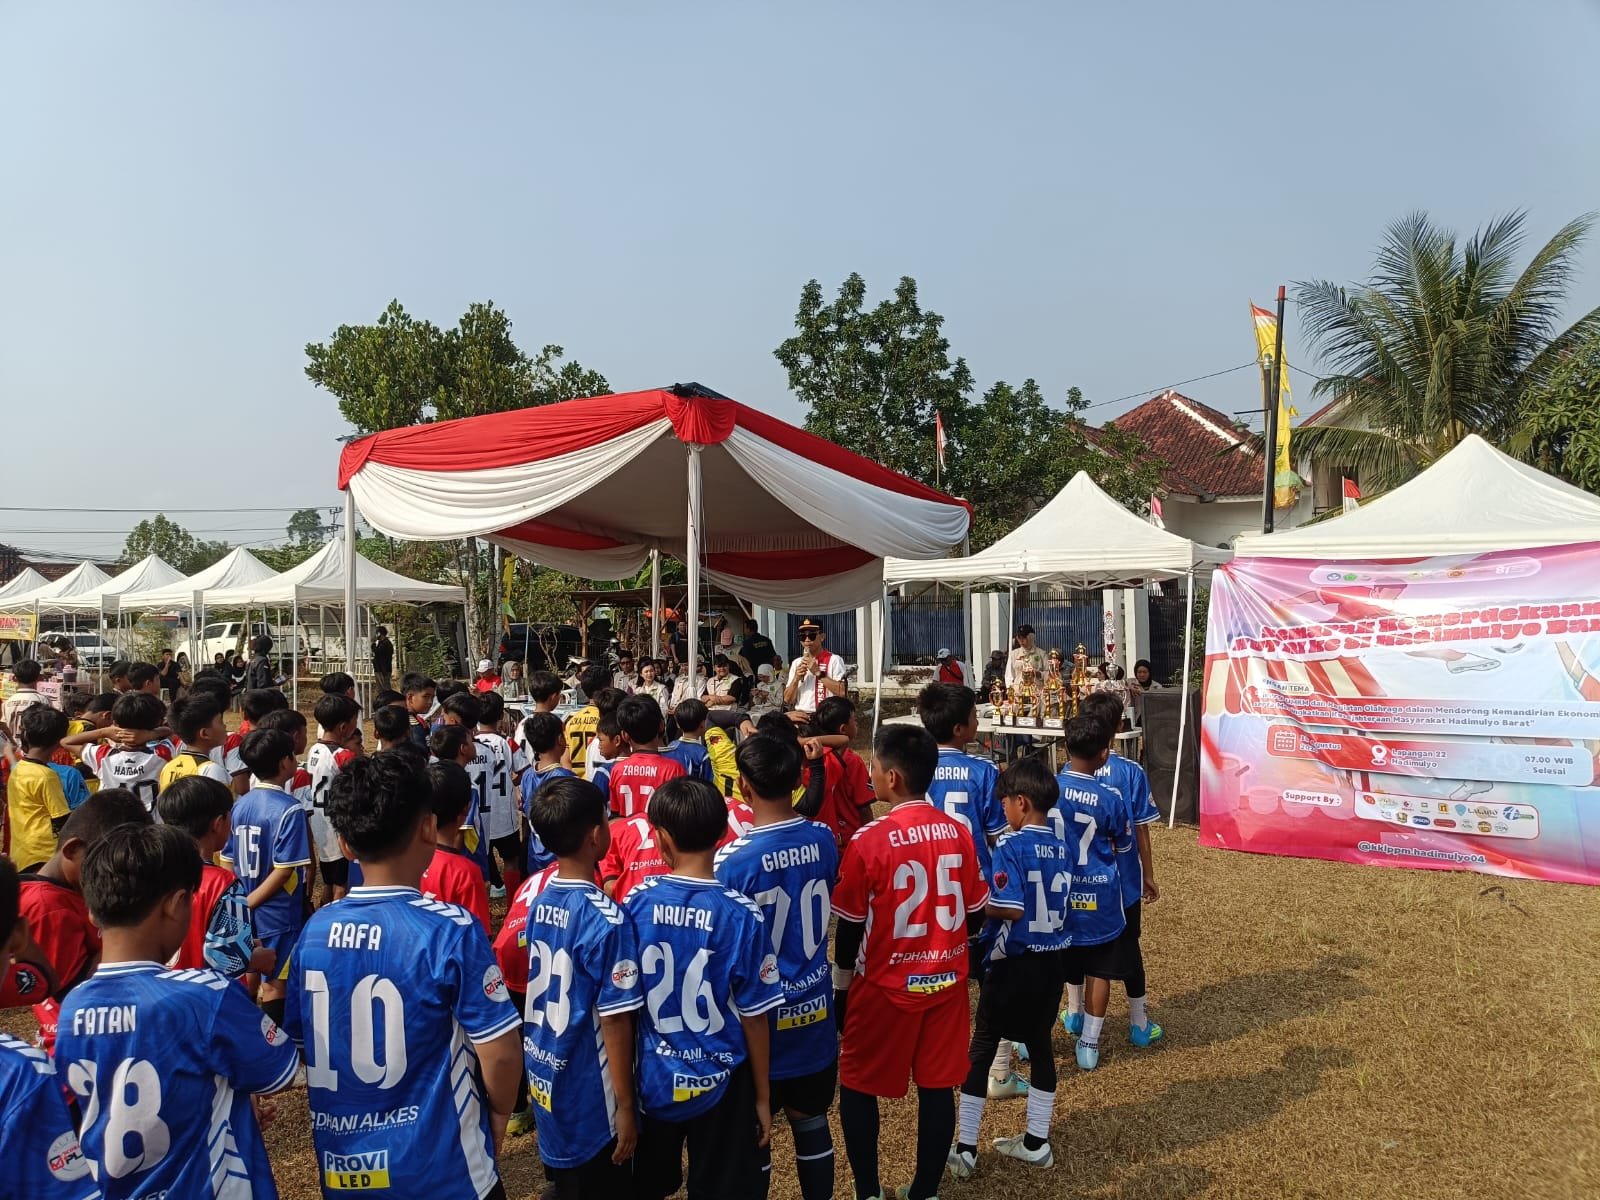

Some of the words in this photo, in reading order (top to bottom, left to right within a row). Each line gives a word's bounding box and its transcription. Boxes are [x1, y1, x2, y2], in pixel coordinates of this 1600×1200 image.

[1393, 716, 1446, 725] Masyarakat
[1448, 717, 1500, 727] Hadimulyo
[1406, 705, 1433, 714] dalam
[1435, 707, 1490, 717] Mendorong
[1491, 708, 1555, 717] Kemandirian
[1391, 758, 1437, 769] Hadimulyo
[1392, 748, 1433, 759] Lapangan
[1435, 750, 1447, 758] 22
[1524, 756, 1551, 764] 07.00
[1554, 757, 1574, 765] WIB
[1532, 766, 1566, 776] Selesai
[1064, 786, 1099, 807] UMAR
[1285, 791, 1321, 802] Support
[1323, 796, 1335, 805] By
[888, 823, 959, 848] ELBIVARO
[761, 843, 820, 873] GIBRAN
[893, 853, 966, 940] 25
[1070, 893, 1096, 902] ROVI
[652, 903, 714, 932] NAUFAL
[754, 878, 831, 961] 70
[327, 921, 383, 951] RAFA
[903, 949, 940, 961] DHANI
[524, 939, 574, 1039] 23
[641, 941, 725, 1036] 26
[780, 979, 808, 991] HANI
[908, 972, 955, 986] PROVI
[780, 998, 826, 1019] PROVI
[72, 1004, 137, 1036] FATAN
[791, 1014, 817, 1027] LED
[305, 969, 408, 1093] 10
[67, 1057, 171, 1182] 28
[316, 1112, 359, 1132] DHANI
[360, 1105, 420, 1129] ALKES
[326, 1151, 386, 1172] PROVI
[339, 1173, 371, 1188] LED
